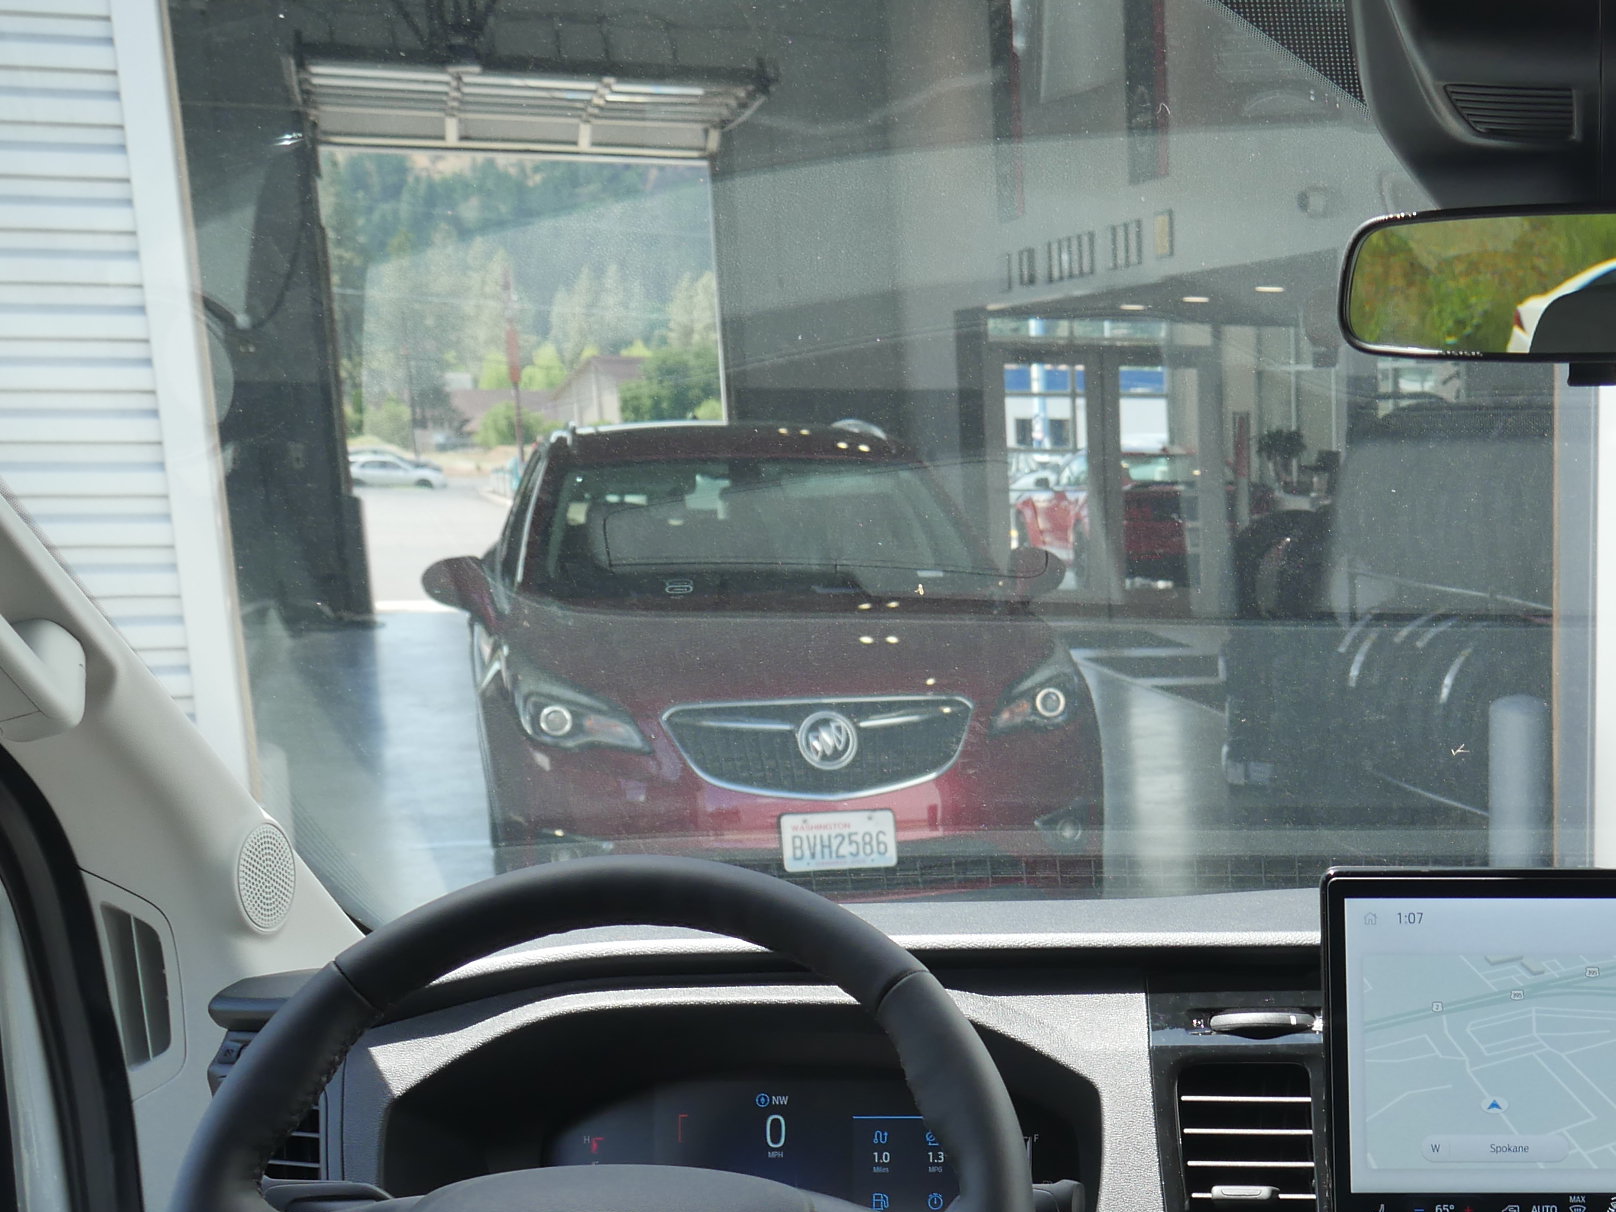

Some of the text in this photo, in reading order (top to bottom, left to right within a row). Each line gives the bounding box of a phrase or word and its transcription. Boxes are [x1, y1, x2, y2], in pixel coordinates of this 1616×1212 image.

[792, 830, 888, 861] BVH2586
[1397, 912, 1424, 925] 1:07
[772, 1096, 788, 1105] NW
[765, 1114, 787, 1148] 0
[583, 1136, 590, 1144] H
[1431, 1144, 1441, 1153] W
[1489, 1144, 1529, 1155] Spokane
[873, 1152, 891, 1163] 1.0
[927, 1151, 945, 1163] 1.3
[1569, 1195, 1586, 1203] MAX
